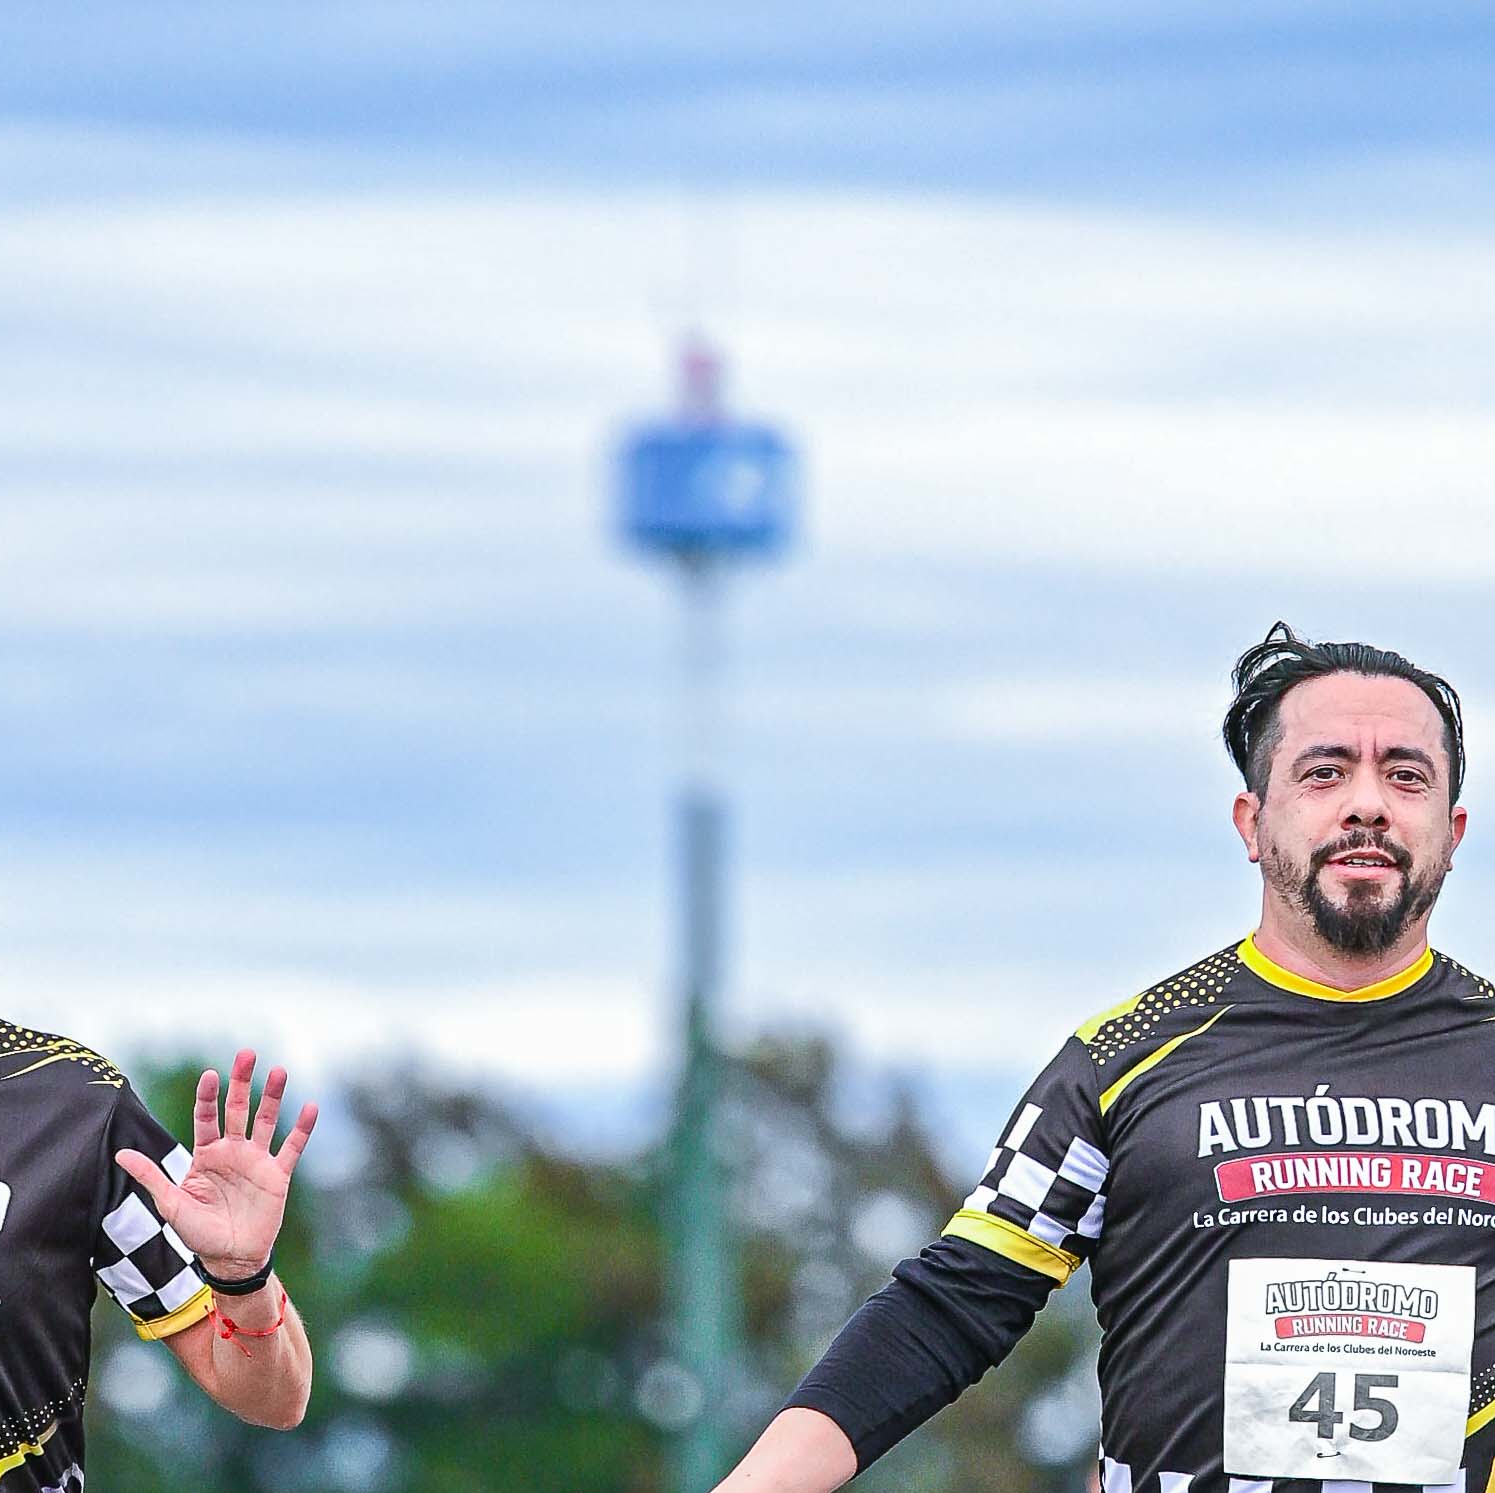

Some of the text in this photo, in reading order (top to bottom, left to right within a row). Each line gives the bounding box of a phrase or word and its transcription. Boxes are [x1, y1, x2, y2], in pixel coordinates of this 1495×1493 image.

[1250, 1157, 1484, 1198] RUNNING RACE
[1193, 1211, 1214, 1229] La
[1217, 1206, 1287, 1226] Carrera
[1292, 1205, 1317, 1224] de
[1321, 1205, 1349, 1225] los
[1353, 1207, 1419, 1226] Clubes
[1423, 1207, 1453, 1226] del
[1266, 1272, 1438, 1319] AUTÓDROMO
[1292, 1316, 1409, 1339] RUNNING RACE
[1260, 1342, 1436, 1357] La Carrera de los Clubes del Noroeste
[1289, 1372, 1399, 1442] 45
